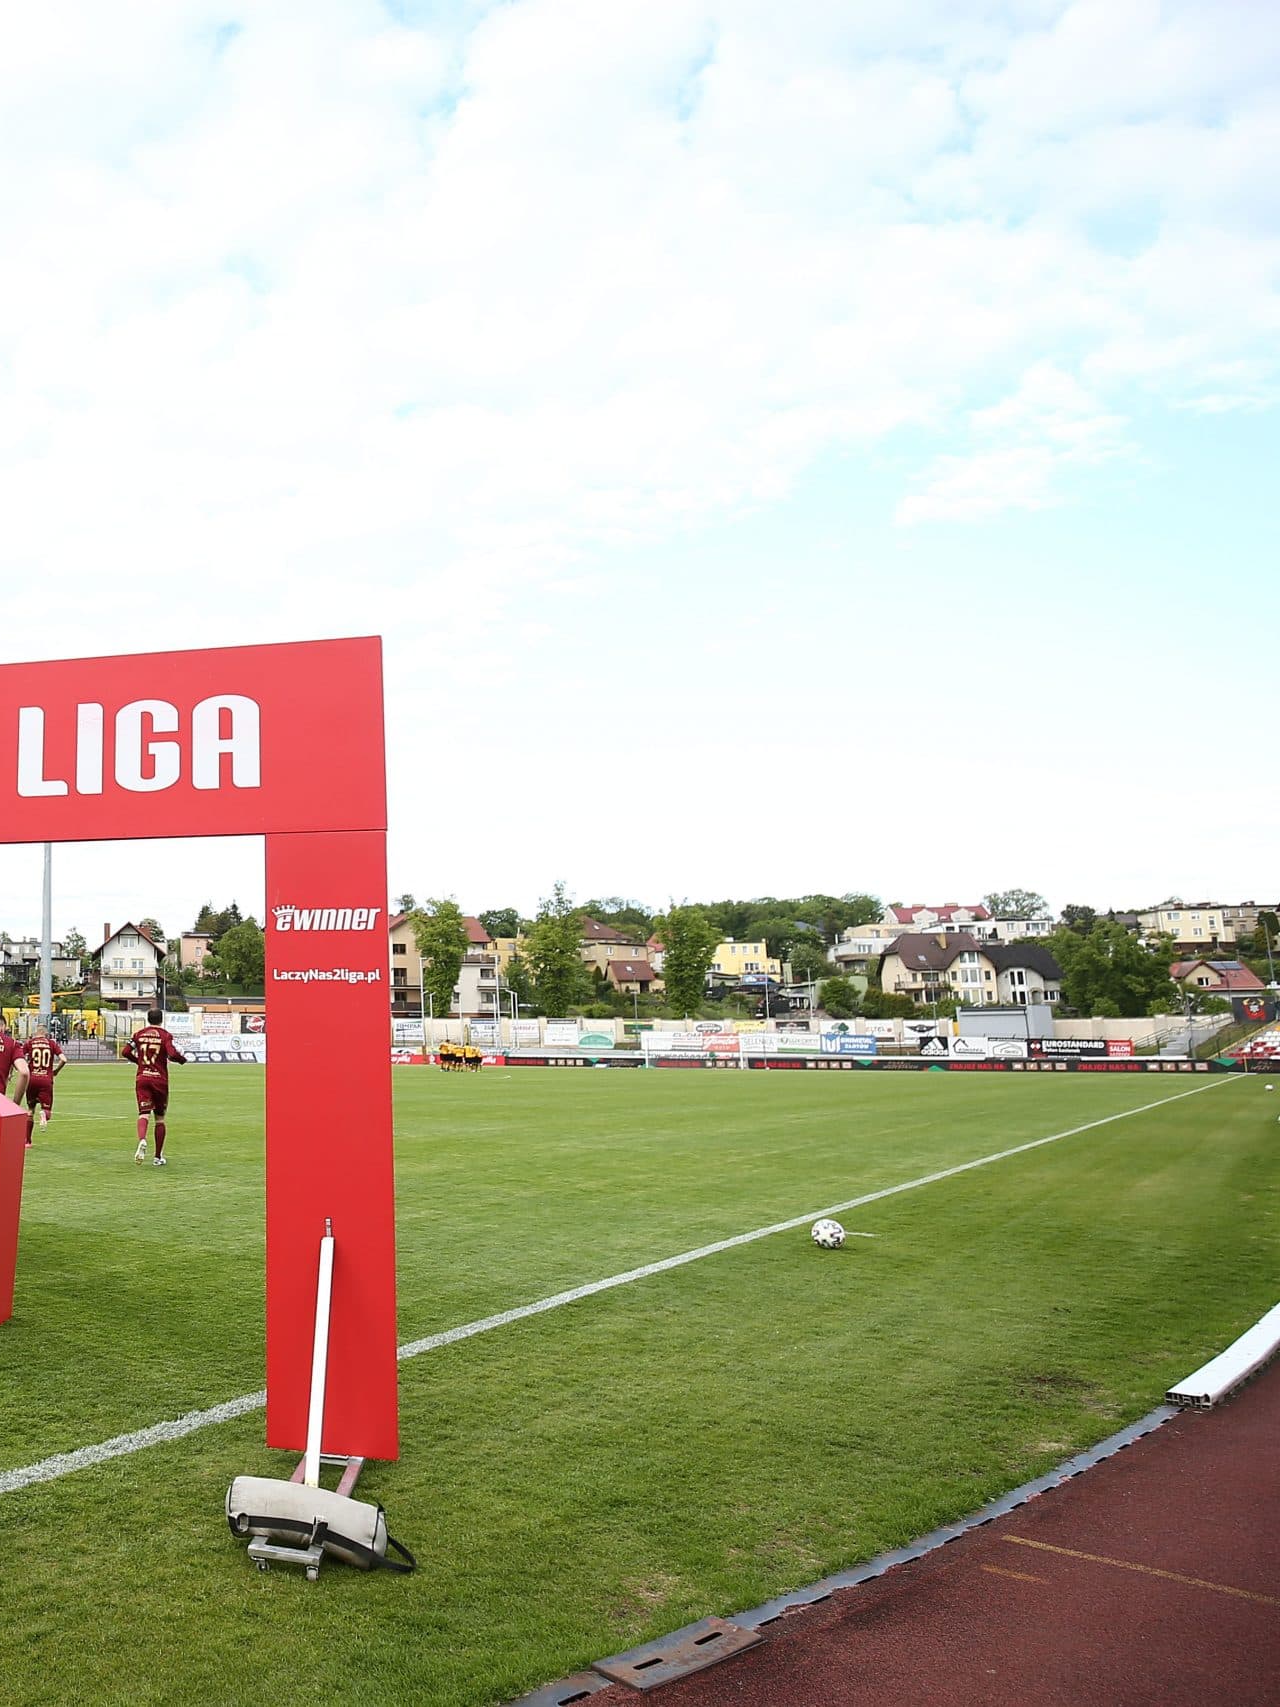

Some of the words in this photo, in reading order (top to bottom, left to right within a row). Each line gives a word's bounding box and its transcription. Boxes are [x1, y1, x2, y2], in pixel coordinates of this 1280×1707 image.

[17, 693, 261, 799] LIGA
[273, 968, 381, 983] LaczyNas2liga.pl
[1041, 1040, 1105, 1049] EUROSTANDARD
[140, 1043, 161, 1066] 17
